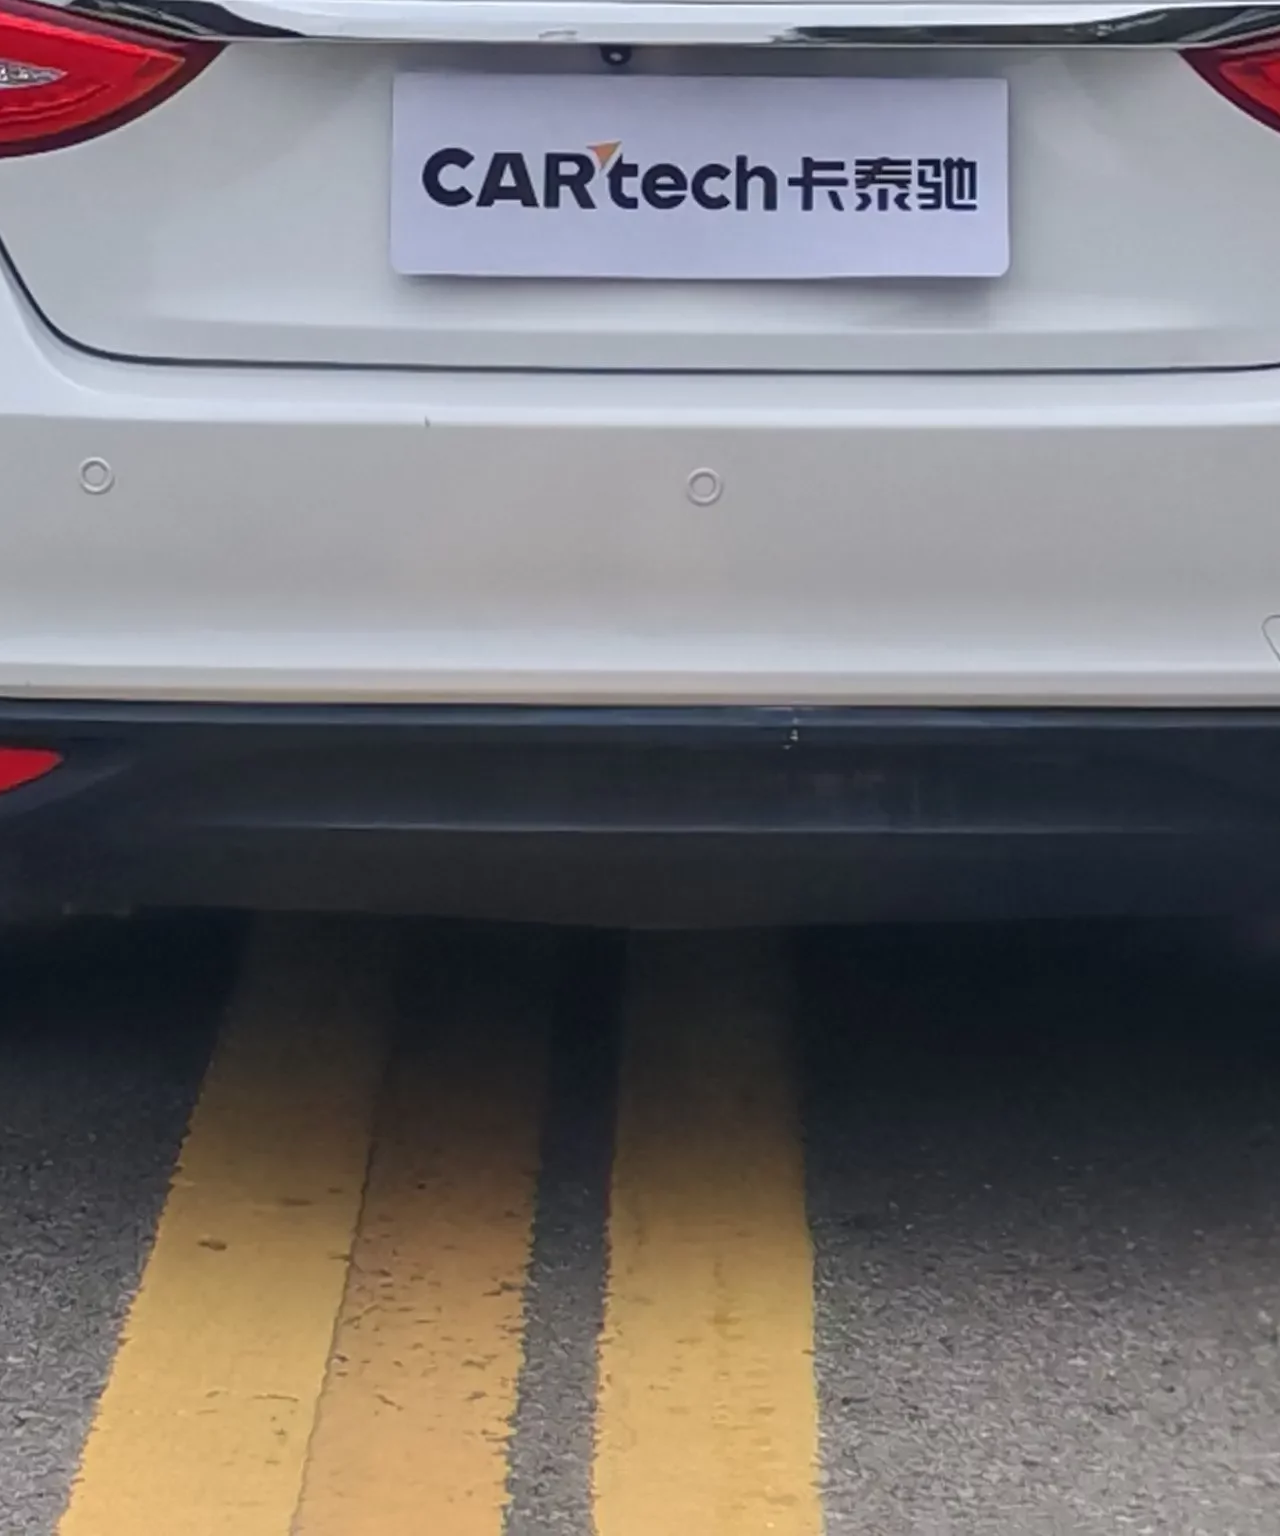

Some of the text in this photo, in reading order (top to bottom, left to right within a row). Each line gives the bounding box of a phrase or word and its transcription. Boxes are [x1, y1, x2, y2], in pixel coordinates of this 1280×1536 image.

[422, 145, 977, 212] CARtech 卡泰驰
